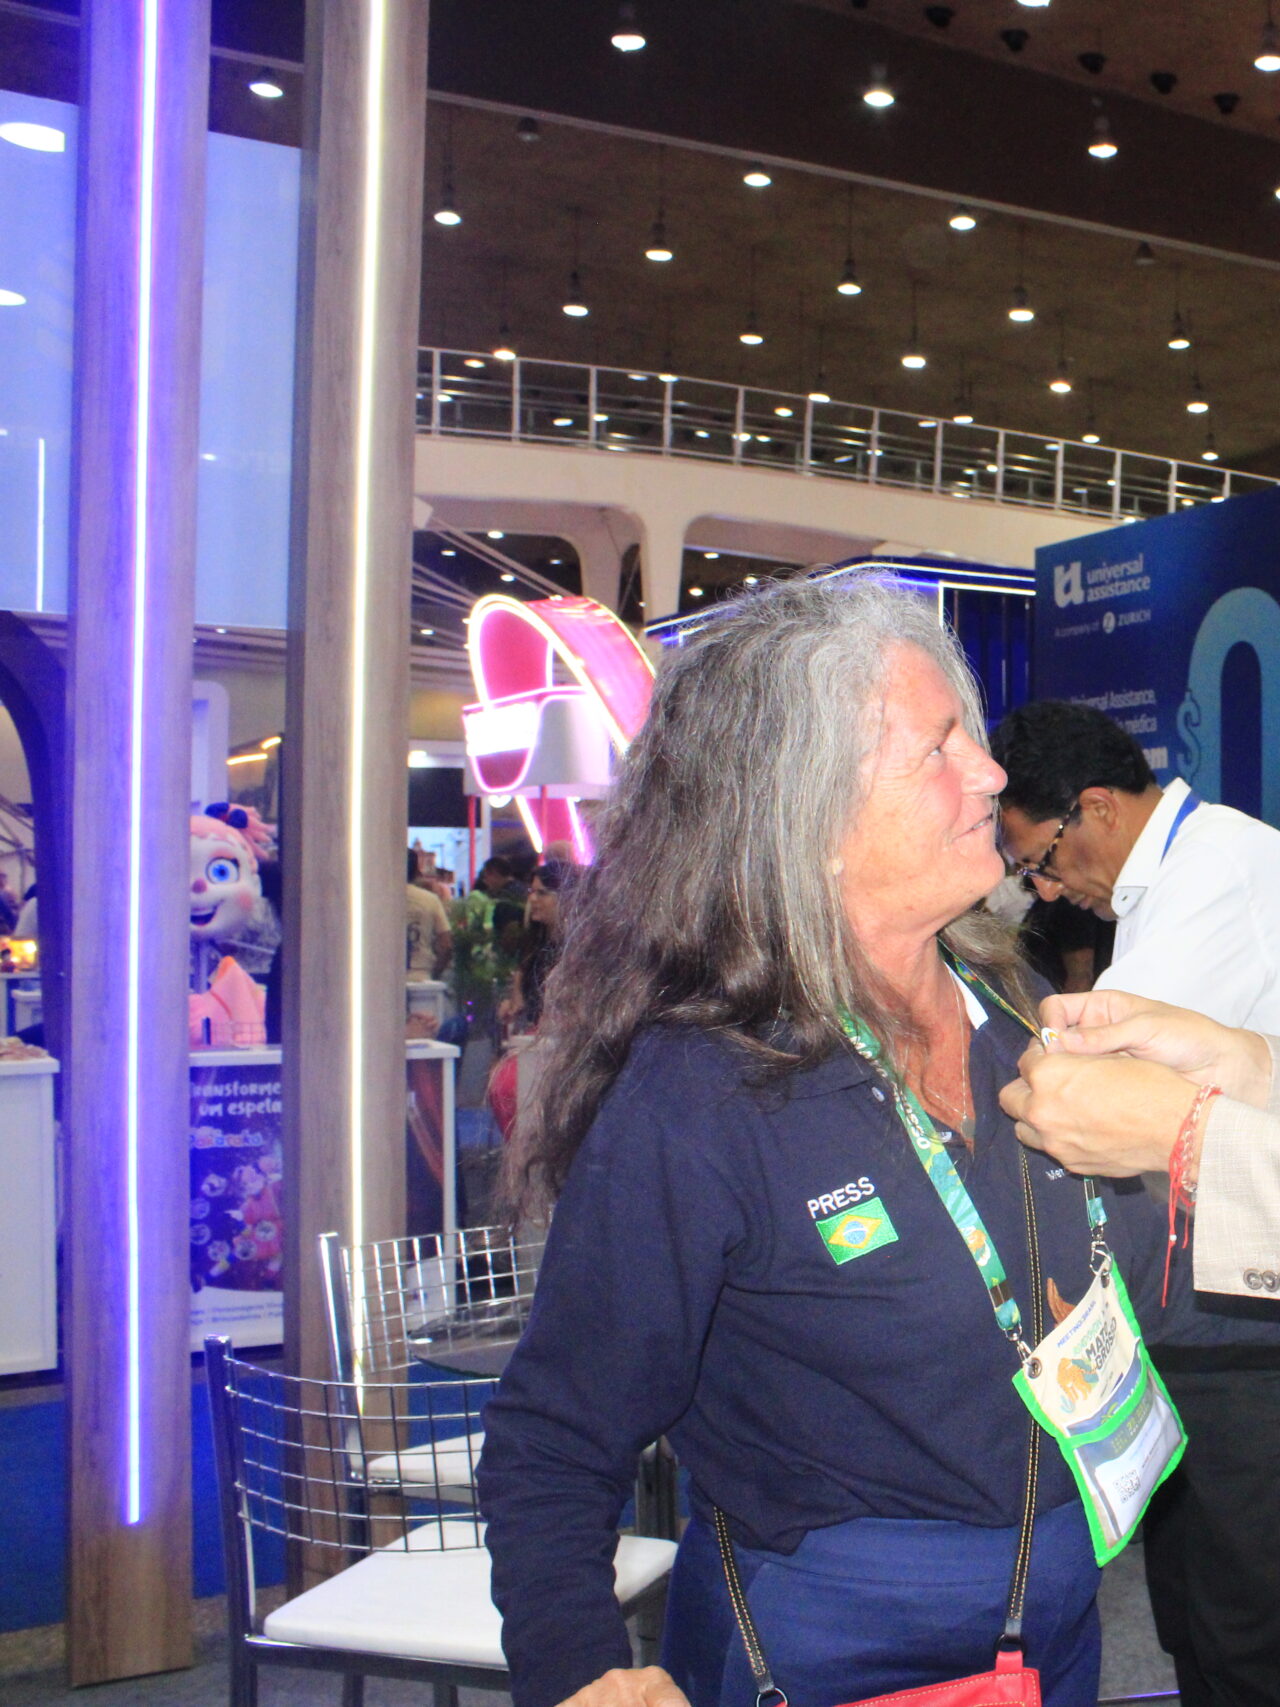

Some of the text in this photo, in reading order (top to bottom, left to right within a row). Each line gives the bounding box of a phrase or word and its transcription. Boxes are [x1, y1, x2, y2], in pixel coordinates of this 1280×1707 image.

[1086, 553, 1144, 585] universal
[1086, 576, 1151, 602] assistance
[1118, 608, 1152, 627] ZURICH
[807, 1176, 875, 1219] PRESS
